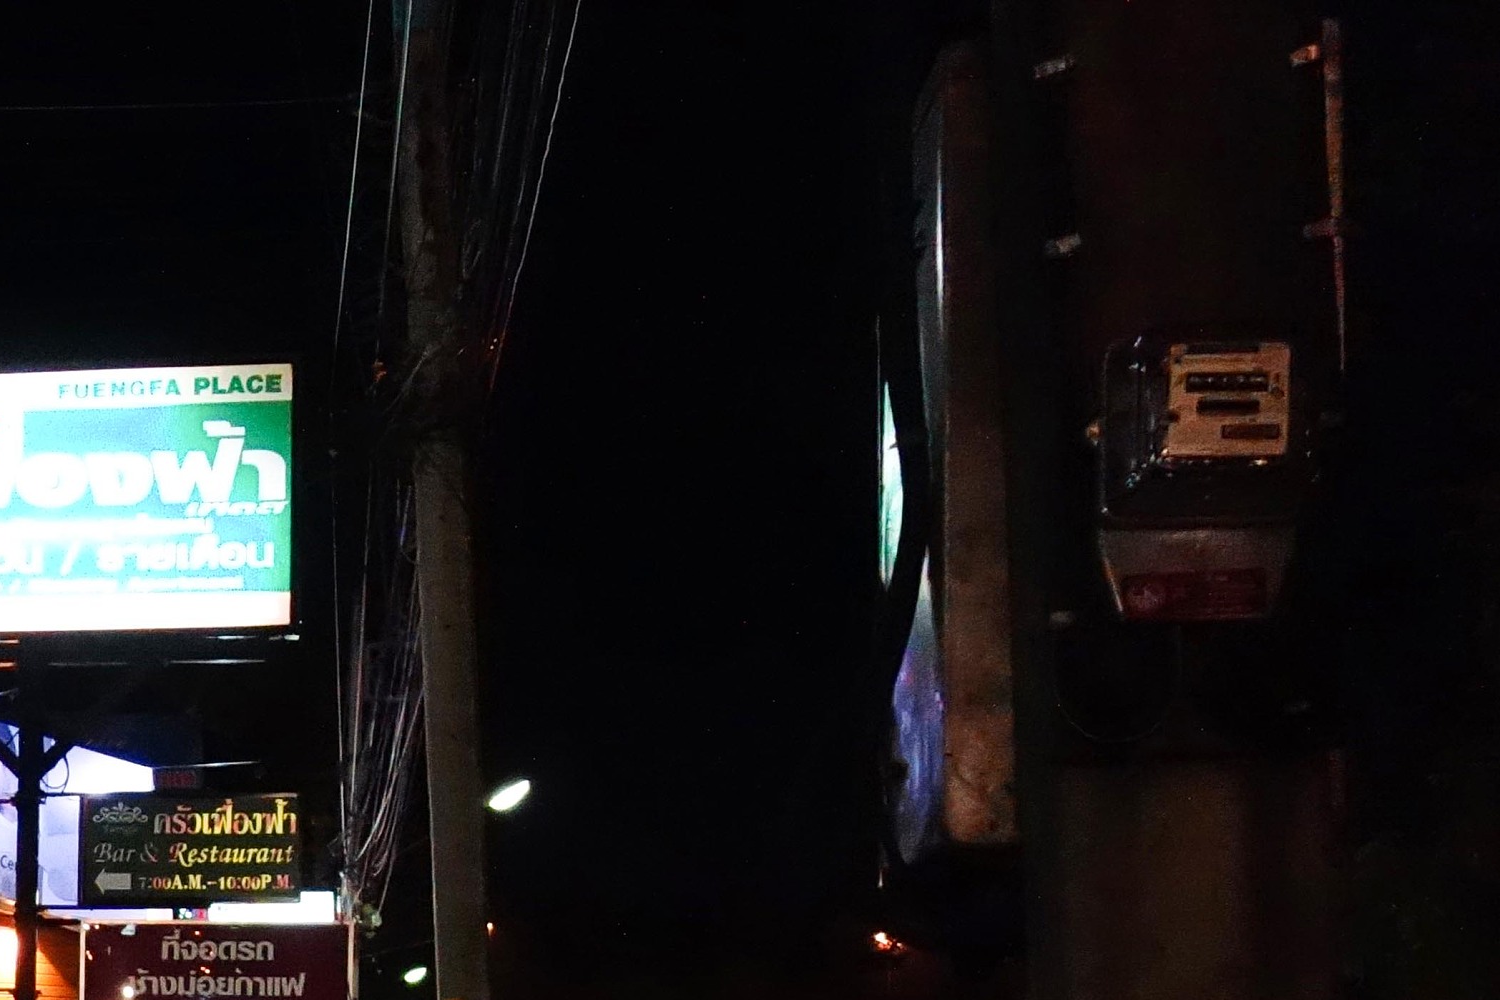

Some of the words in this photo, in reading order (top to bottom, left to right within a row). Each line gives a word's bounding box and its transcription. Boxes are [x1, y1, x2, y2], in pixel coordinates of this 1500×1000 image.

[58, 378, 180, 399] FUENGFA
[194, 374, 282, 395] PLACE
[93, 842, 137, 863] Bar
[139, 842, 159, 863] &
[168, 842, 294, 868] Restaurant
[160, 928, 274, 961] ที่จอดรถ
